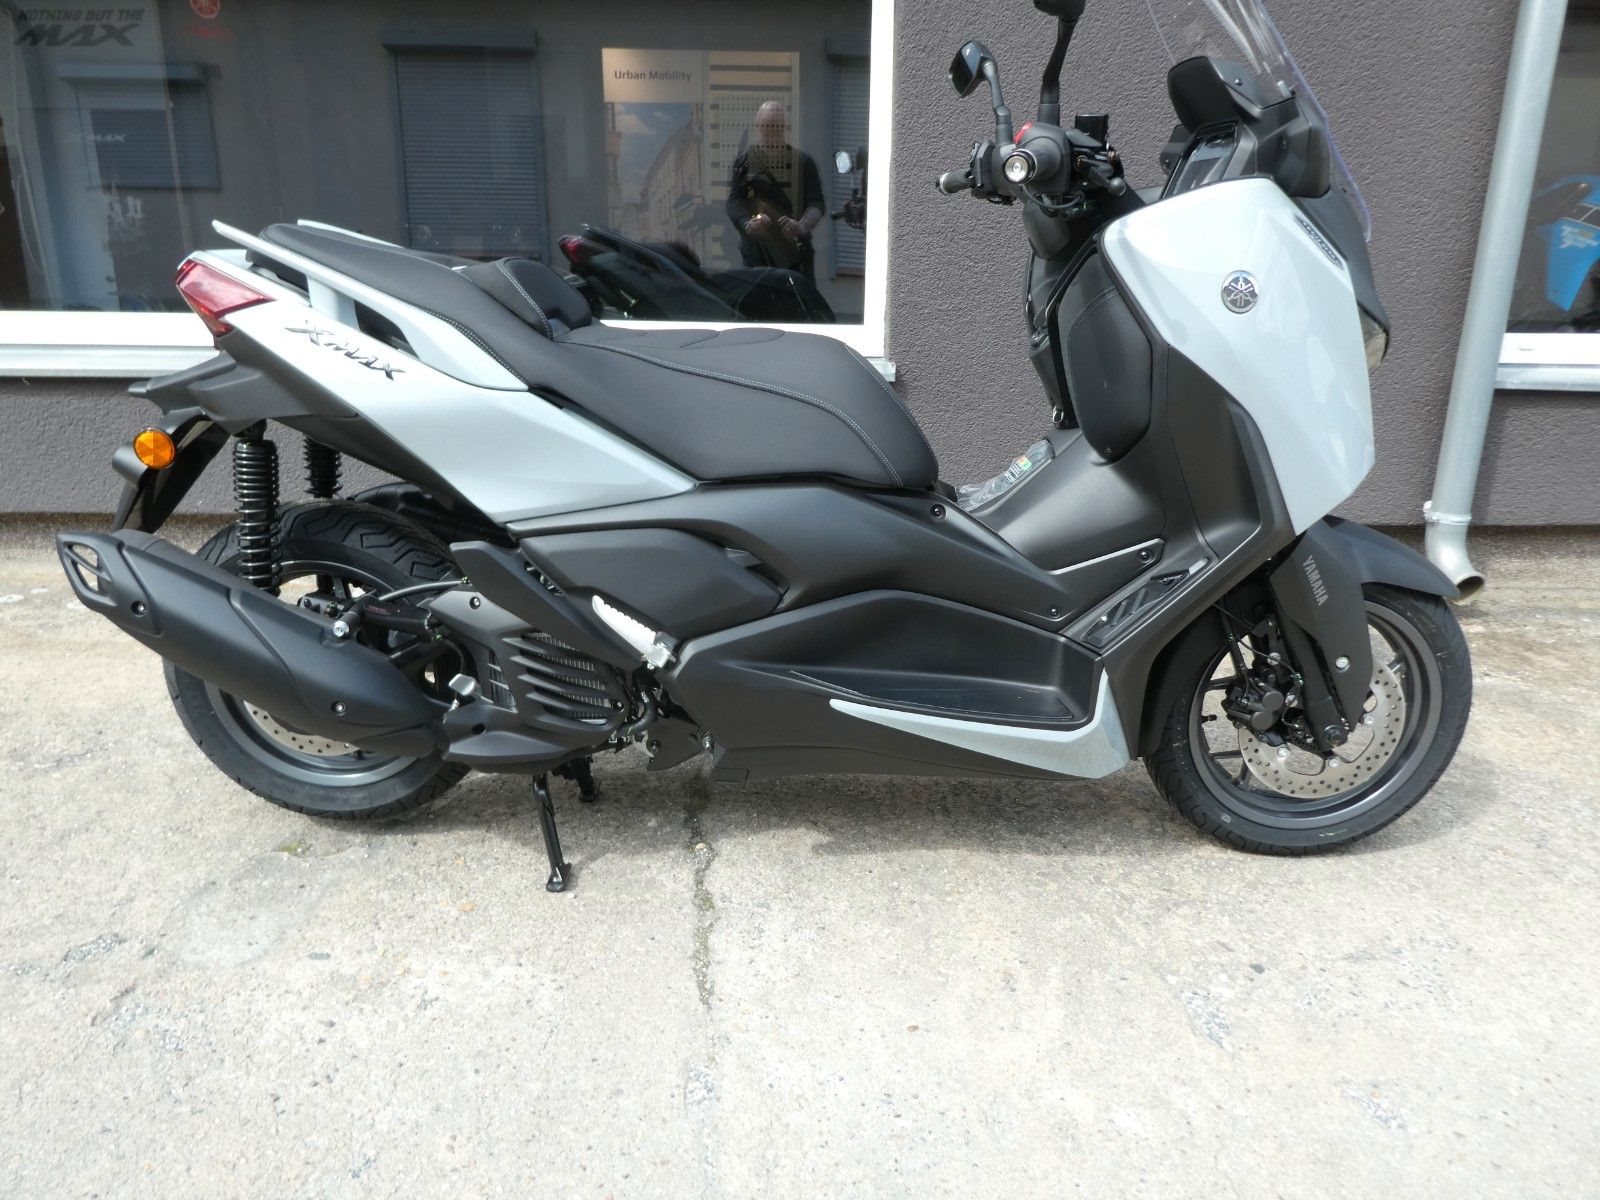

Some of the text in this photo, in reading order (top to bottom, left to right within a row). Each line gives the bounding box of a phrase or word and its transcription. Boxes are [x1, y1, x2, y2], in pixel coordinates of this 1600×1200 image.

[19, 8, 146, 21] NOTHING BUT THE
[14, 23, 140, 47] MAX
[614, 70, 692, 83] Urban Mobility
[1303, 555, 1329, 606] YAMAHA
